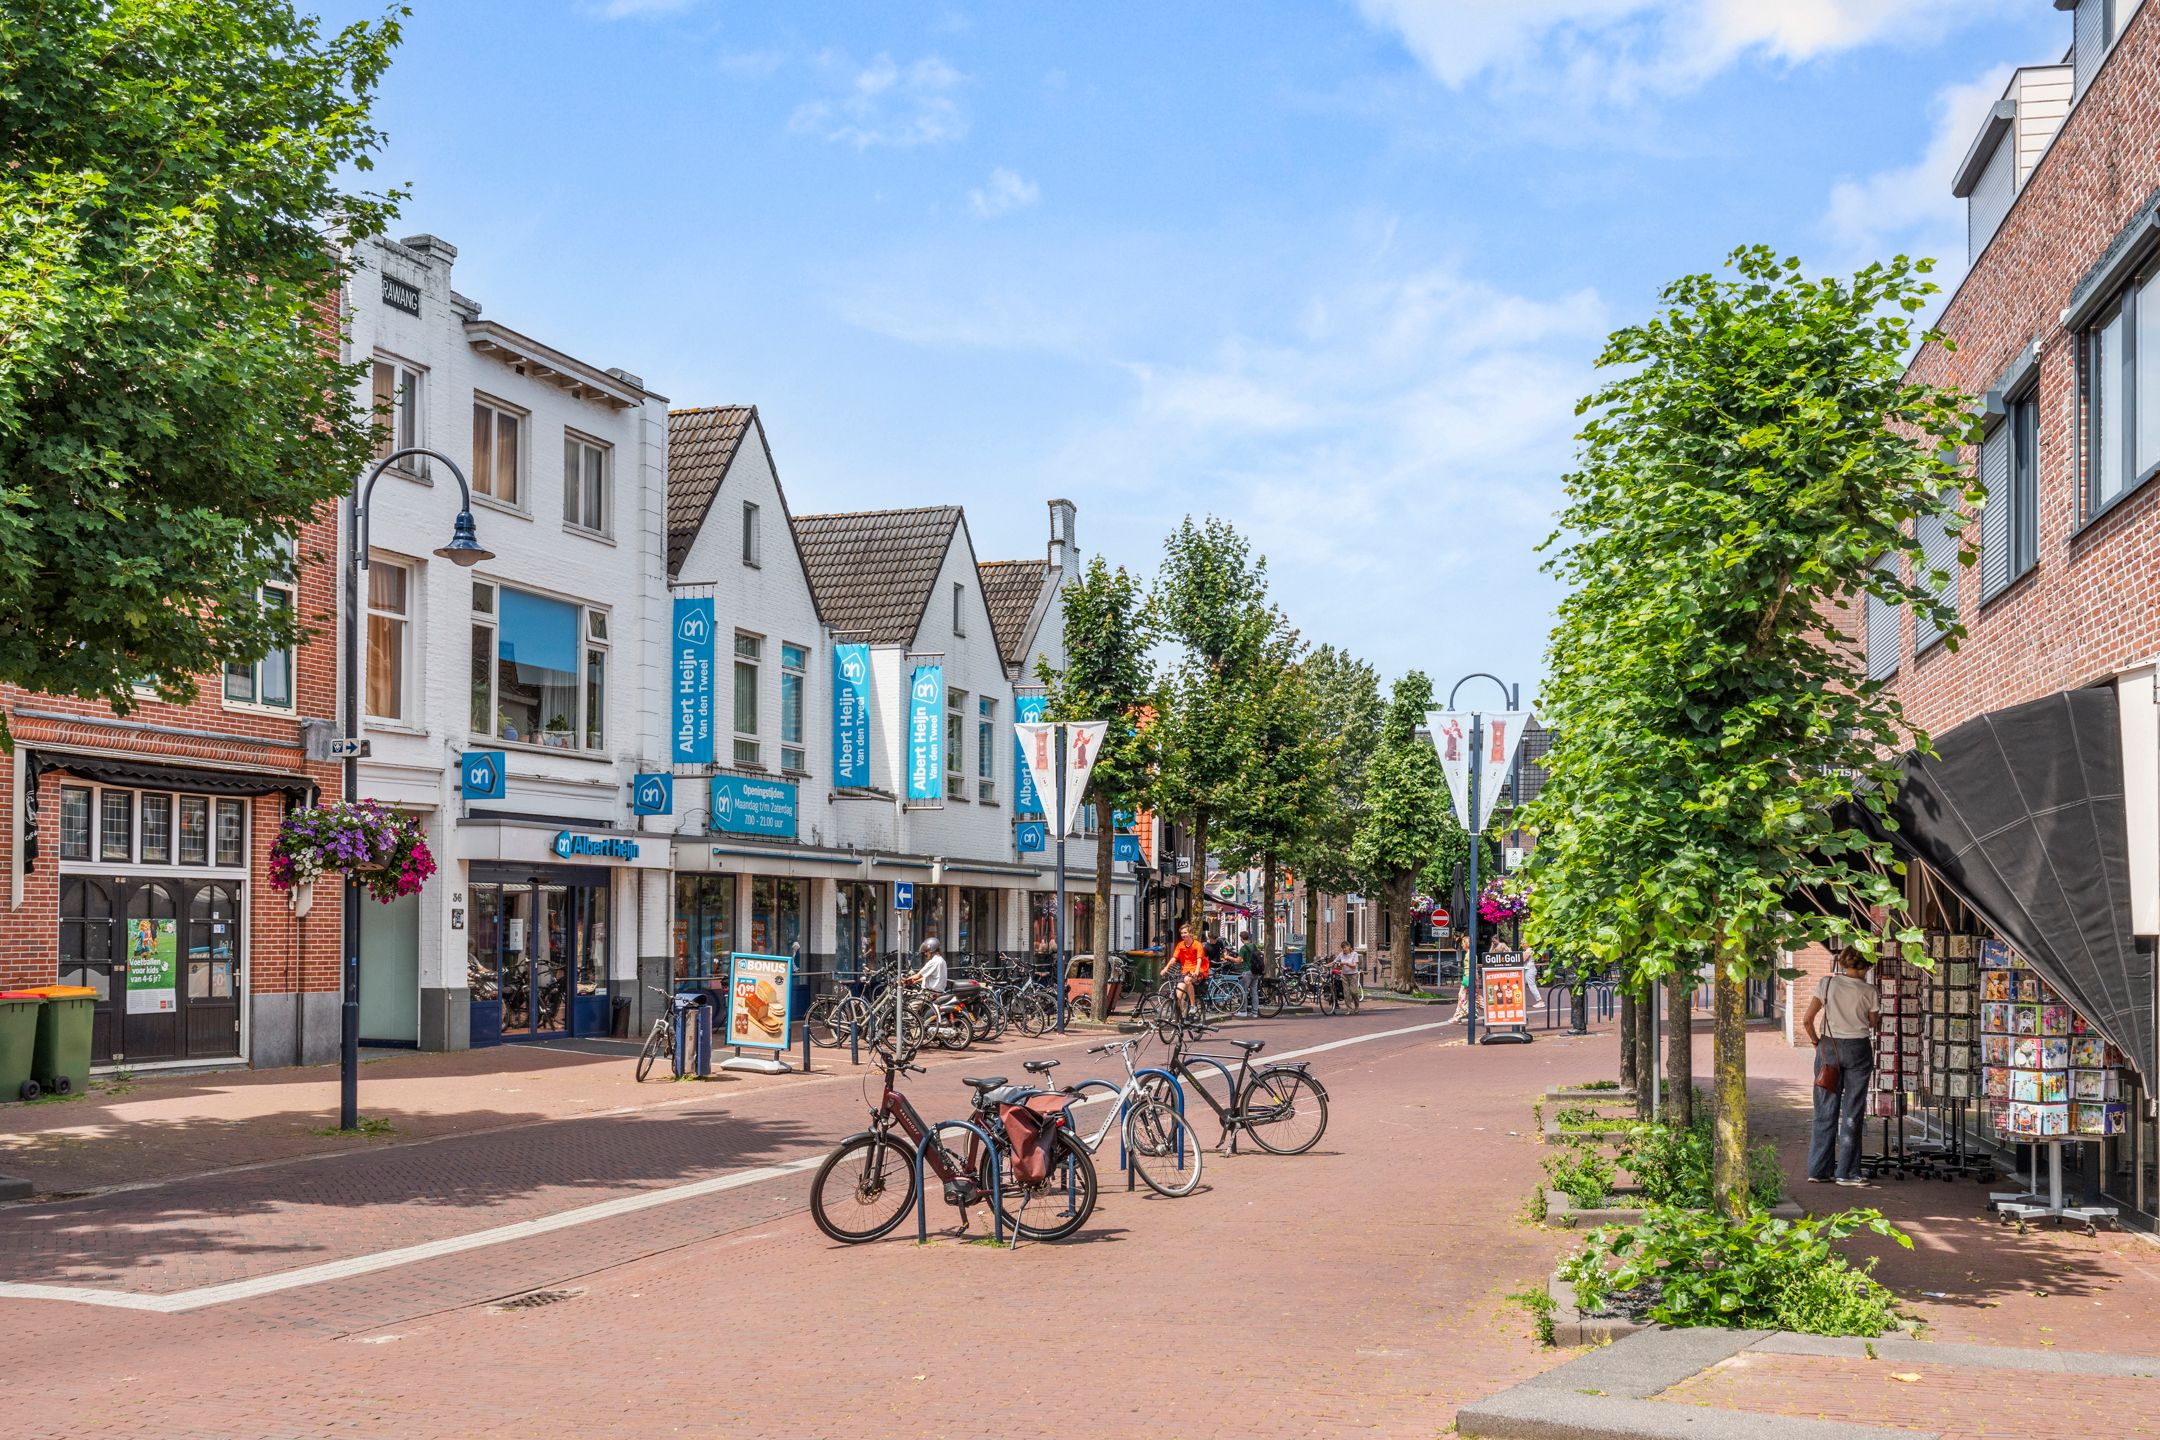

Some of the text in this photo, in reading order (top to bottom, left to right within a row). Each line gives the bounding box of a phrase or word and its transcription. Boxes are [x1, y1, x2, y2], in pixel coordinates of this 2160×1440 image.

[382, 280, 418, 310] RAWANG
[679, 649, 698, 754] Albert Heijn
[698, 659, 709, 740] Van den Tweel
[839, 687, 856, 778] Albert Heijn
[856, 696, 865, 767] Van den Tweel
[913, 706, 929, 791] Albert Heijn
[929, 715, 938, 780] Van den Tweel
[742, 783, 785, 800] Openingstijden:
[1020, 767, 1032, 806] Albert
[734, 798, 793, 817] Maandag t/m Zaterdag
[760, 816, 774, 828] 21.00
[774, 819, 784, 828] uur
[573, 836, 611, 855] Albert
[609, 839, 640, 861] Heijn
[452, 893, 463, 903] 36
[129, 957, 161, 966] Voetballen
[146, 966, 159, 974] kids
[747, 960, 786, 973] BONUS
[1485, 954, 1501, 964] Gall
[1504, 954, 1521, 963] Gall
[153, 974, 162, 983] jr?
